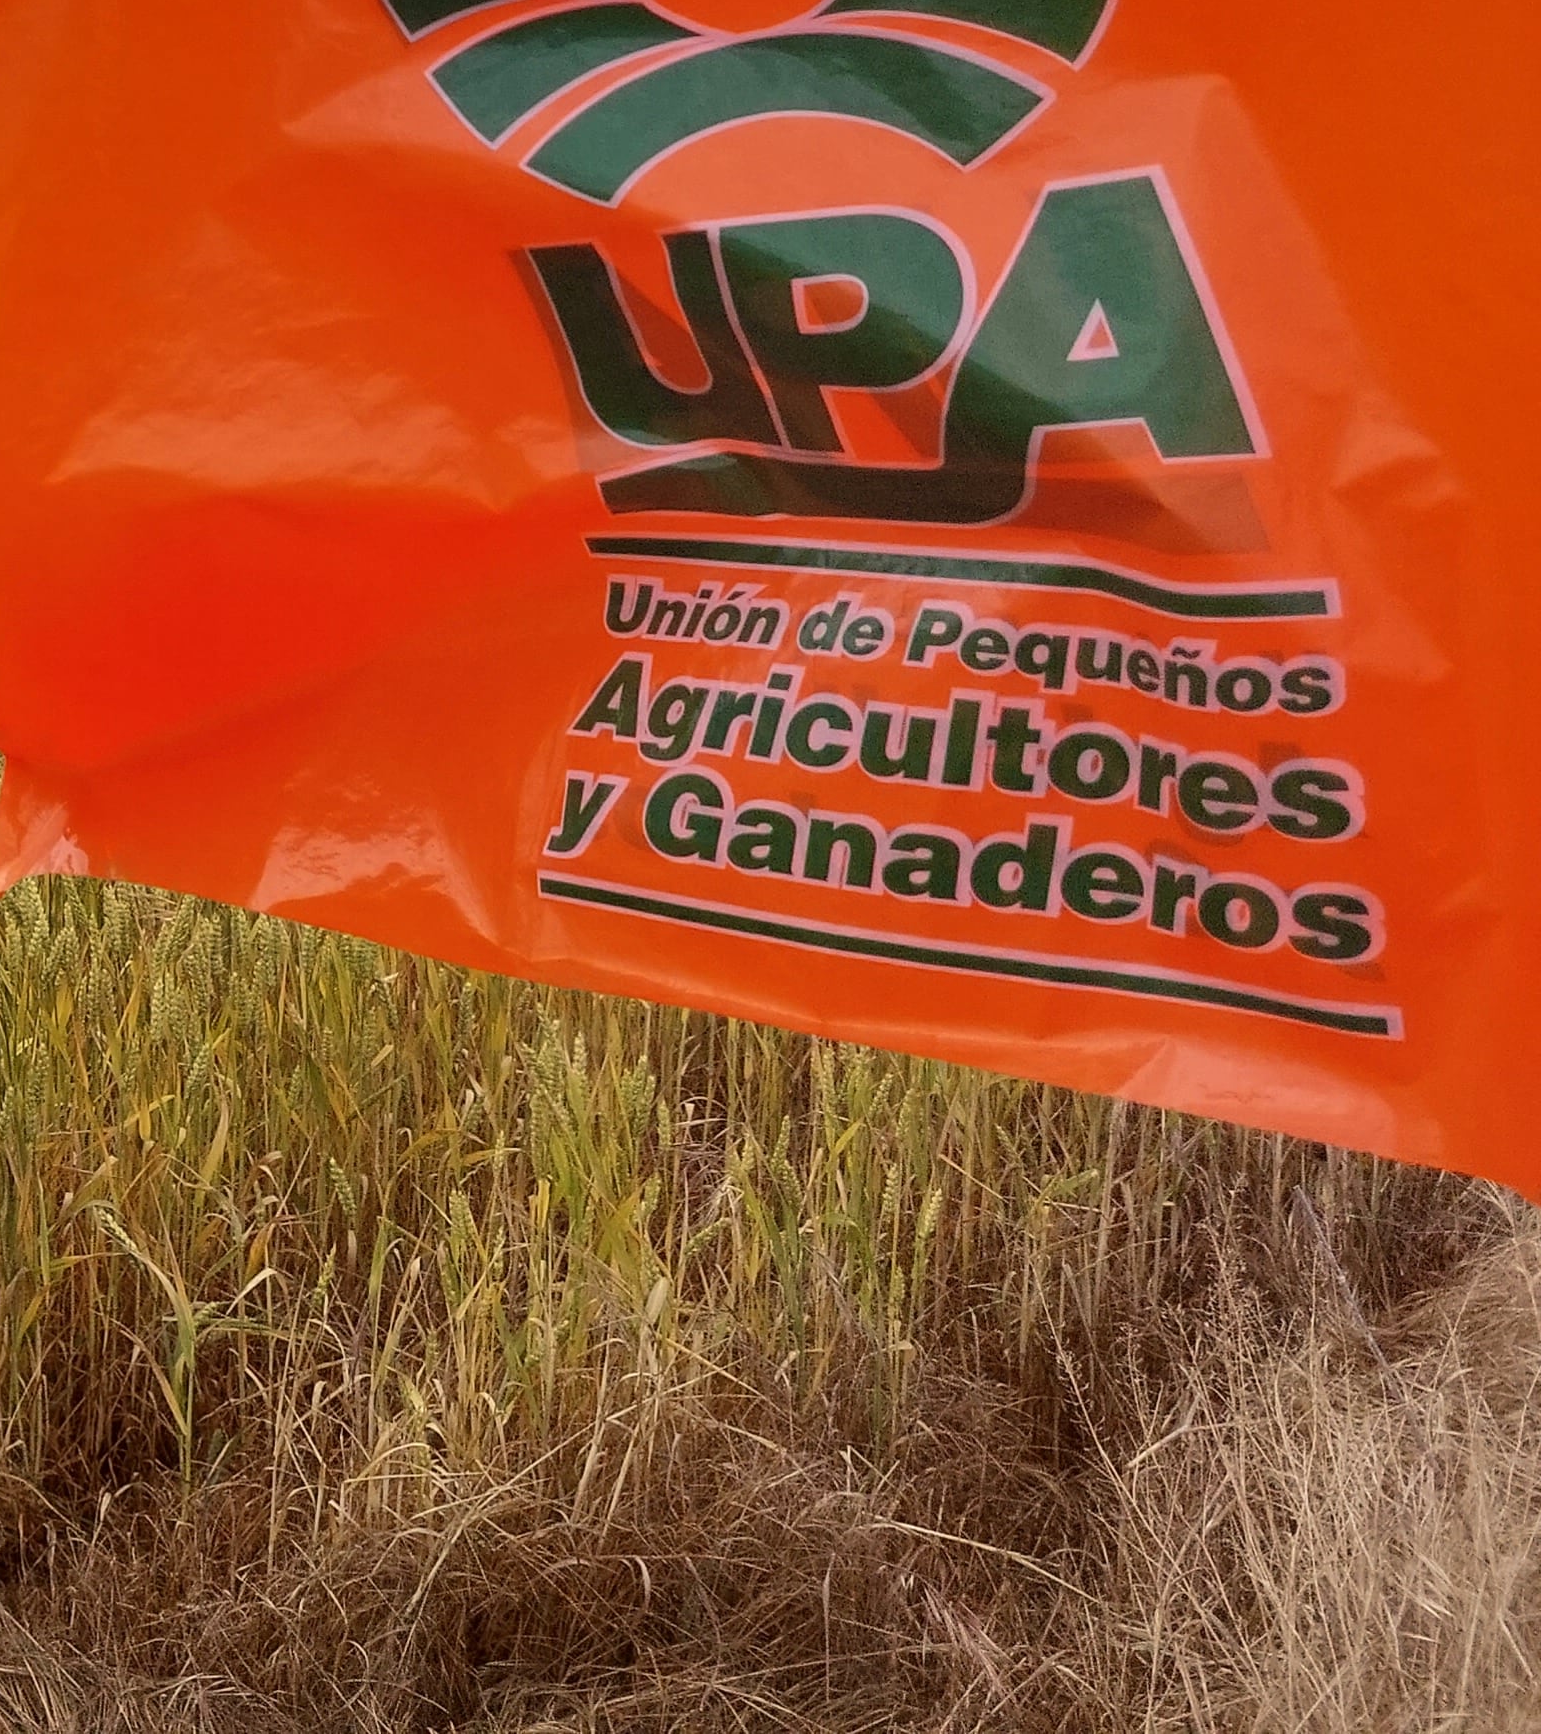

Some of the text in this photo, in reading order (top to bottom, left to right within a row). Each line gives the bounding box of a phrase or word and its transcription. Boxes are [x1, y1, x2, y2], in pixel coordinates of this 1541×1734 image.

[525, 166, 1269, 522] UPA
[605, 580, 1334, 714] Unión de Pequeños
[571, 656, 1354, 839] Agricultores
[547, 773, 1374, 961] y Ganaderos
